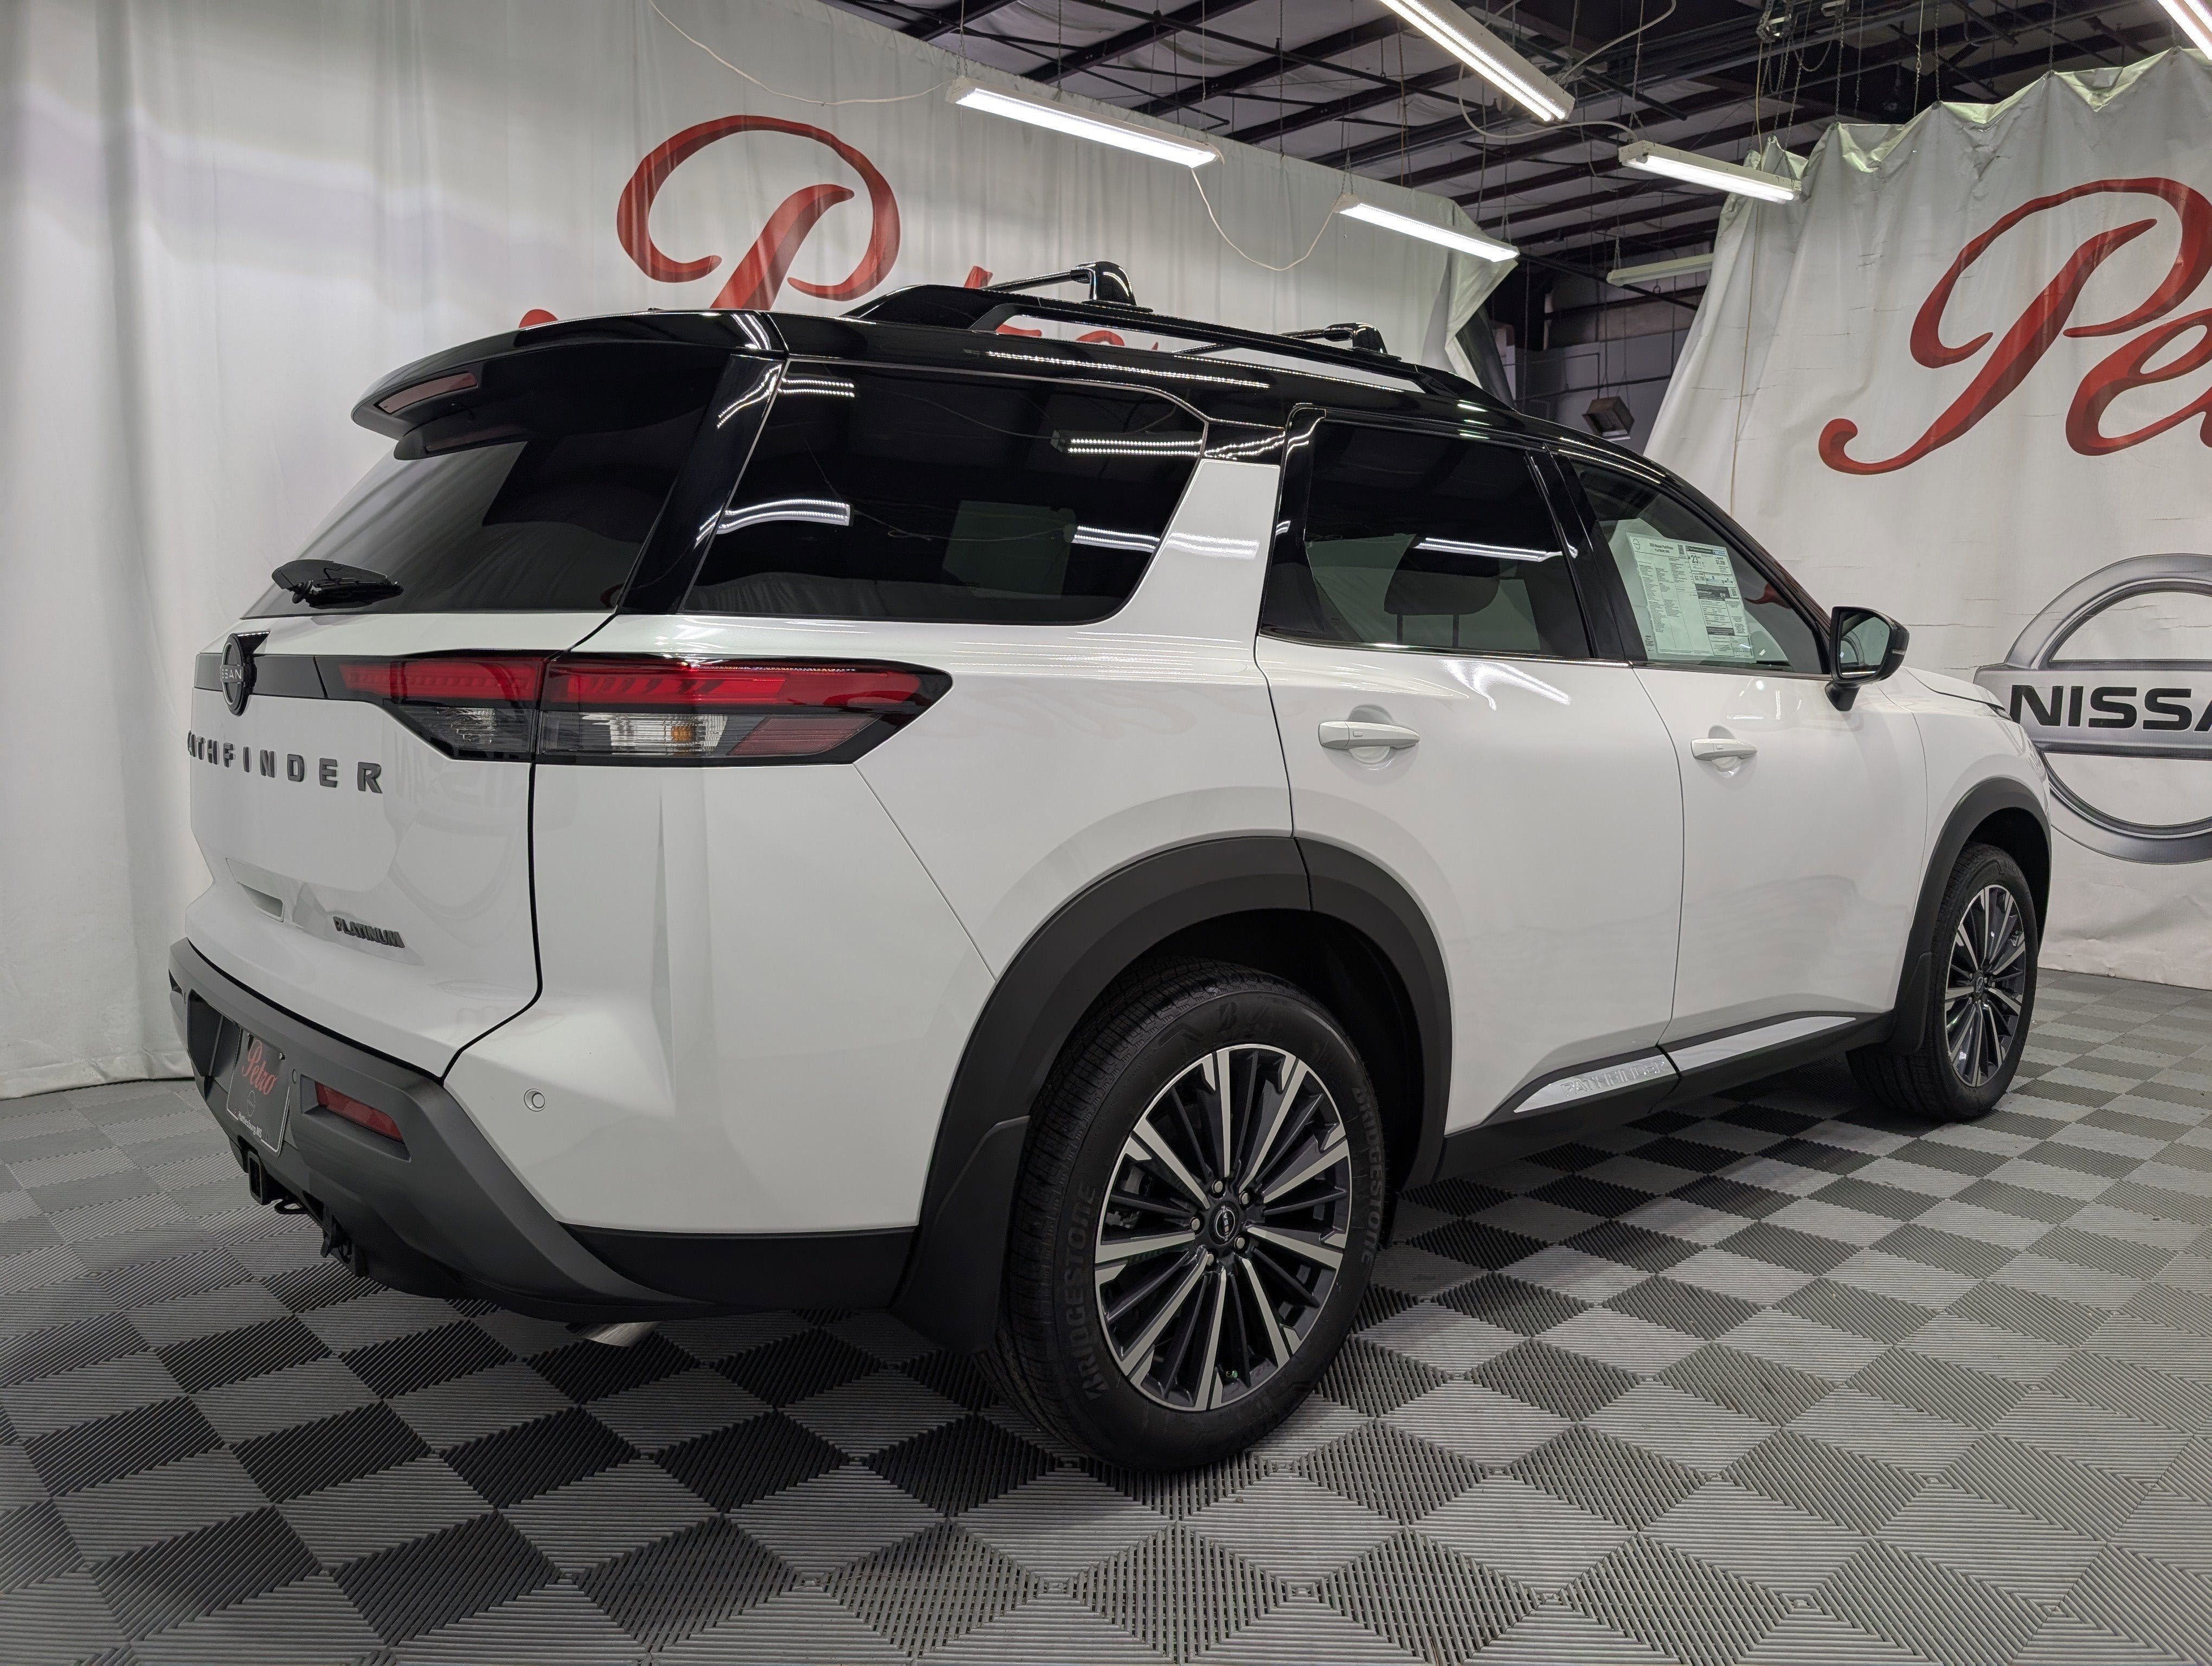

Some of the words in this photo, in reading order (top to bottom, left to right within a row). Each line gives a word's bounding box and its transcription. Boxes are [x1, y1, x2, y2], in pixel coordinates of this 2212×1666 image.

[1818, 176, 2212, 476] Pe
[187, 729, 383, 794] ATHFINDER
[333, 916, 406, 948] PLATINUM
[242, 1040, 277, 1094] Petro
[1560, 1060, 1666, 1097] PATHFINDER
[1065, 1183, 1108, 1399] BRIDGESTONE
